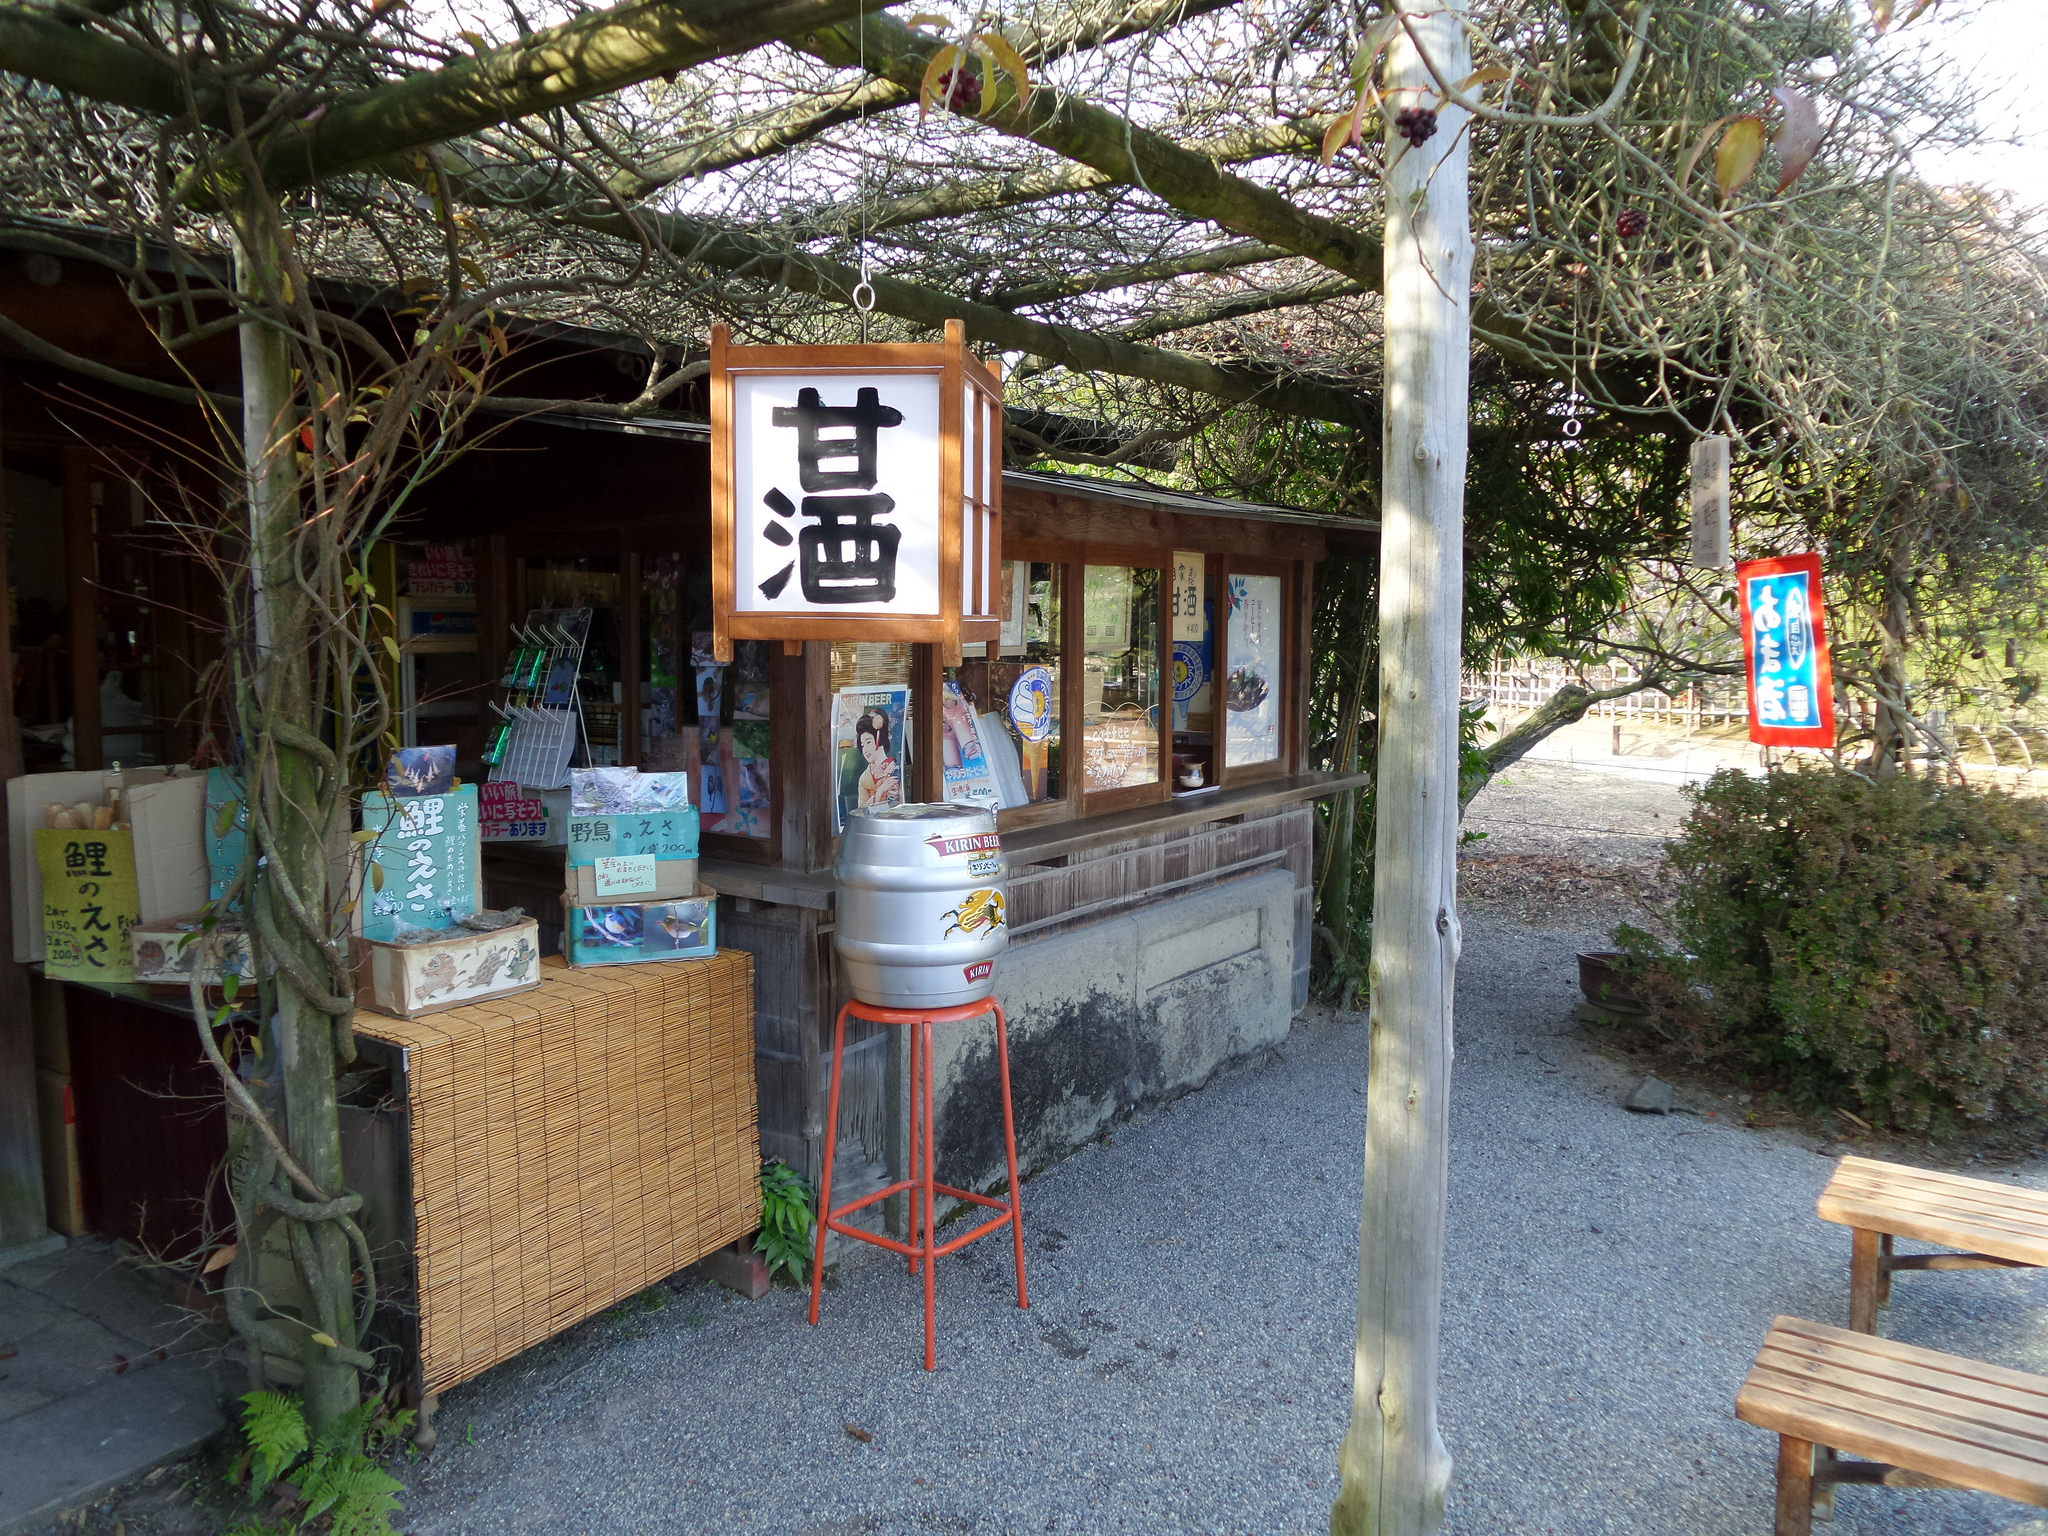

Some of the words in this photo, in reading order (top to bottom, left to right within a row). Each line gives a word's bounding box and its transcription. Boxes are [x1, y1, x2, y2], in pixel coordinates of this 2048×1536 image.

[758, 387, 904, 604] 甘酒
[843, 694, 868, 707] KIRIN
[868, 693, 892, 706] BEER
[571, 820, 673, 843] 野鳥のえさ
[397, 797, 445, 911] 鯉のえさ
[945, 837, 982, 854] KIRIN
[64, 841, 112, 968] 鯉のえさ
[970, 965, 990, 979] KIRIN
